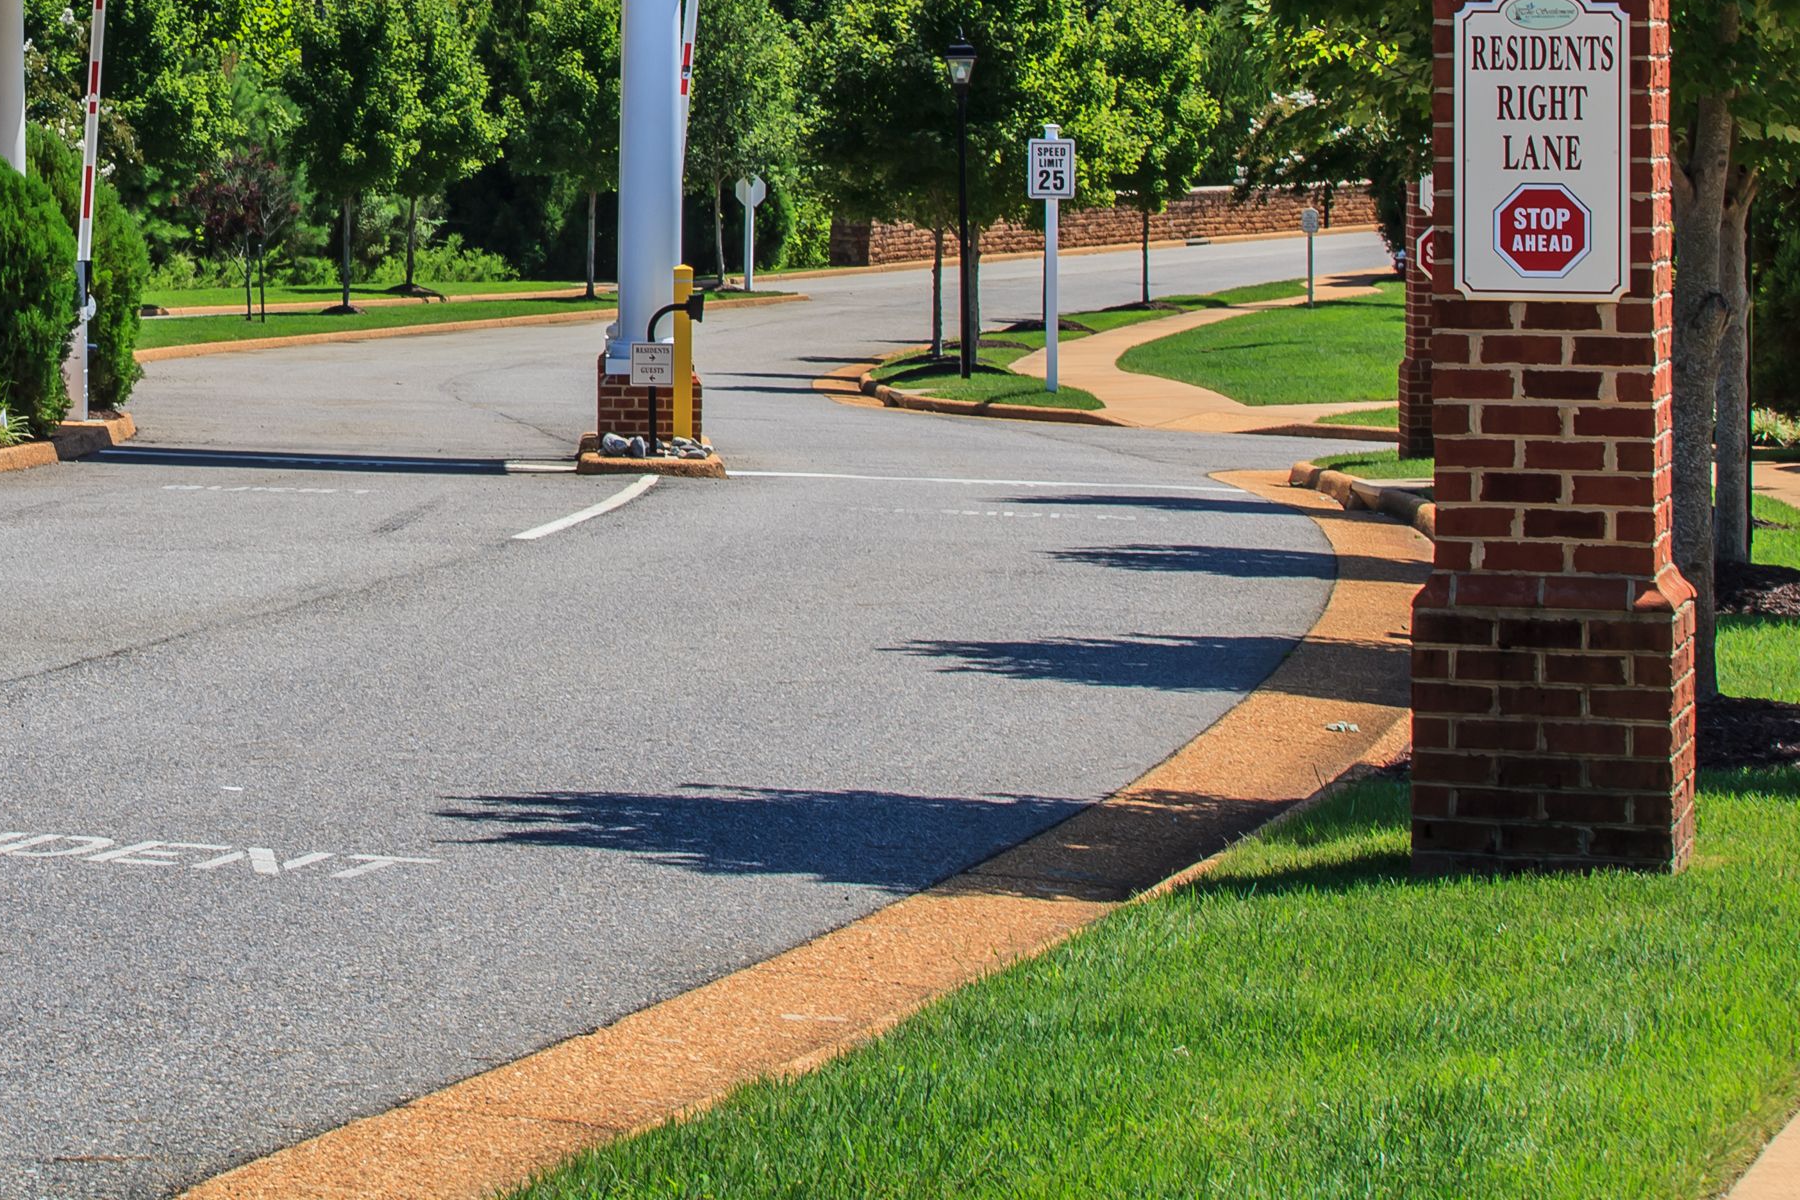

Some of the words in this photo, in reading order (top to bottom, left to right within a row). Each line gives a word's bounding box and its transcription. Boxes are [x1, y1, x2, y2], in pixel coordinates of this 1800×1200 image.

[1471, 35, 1614, 71] RESIDENTS
[1496, 85, 1588, 121] RIGHT
[1037, 147, 1066, 156] SPEED
[1502, 135, 1582, 171] LANE
[1039, 159, 1063, 167] LIMIT
[1038, 170, 1065, 191] 25
[1513, 207, 1571, 230] STOP
[1512, 234, 1573, 252] AHEAD
